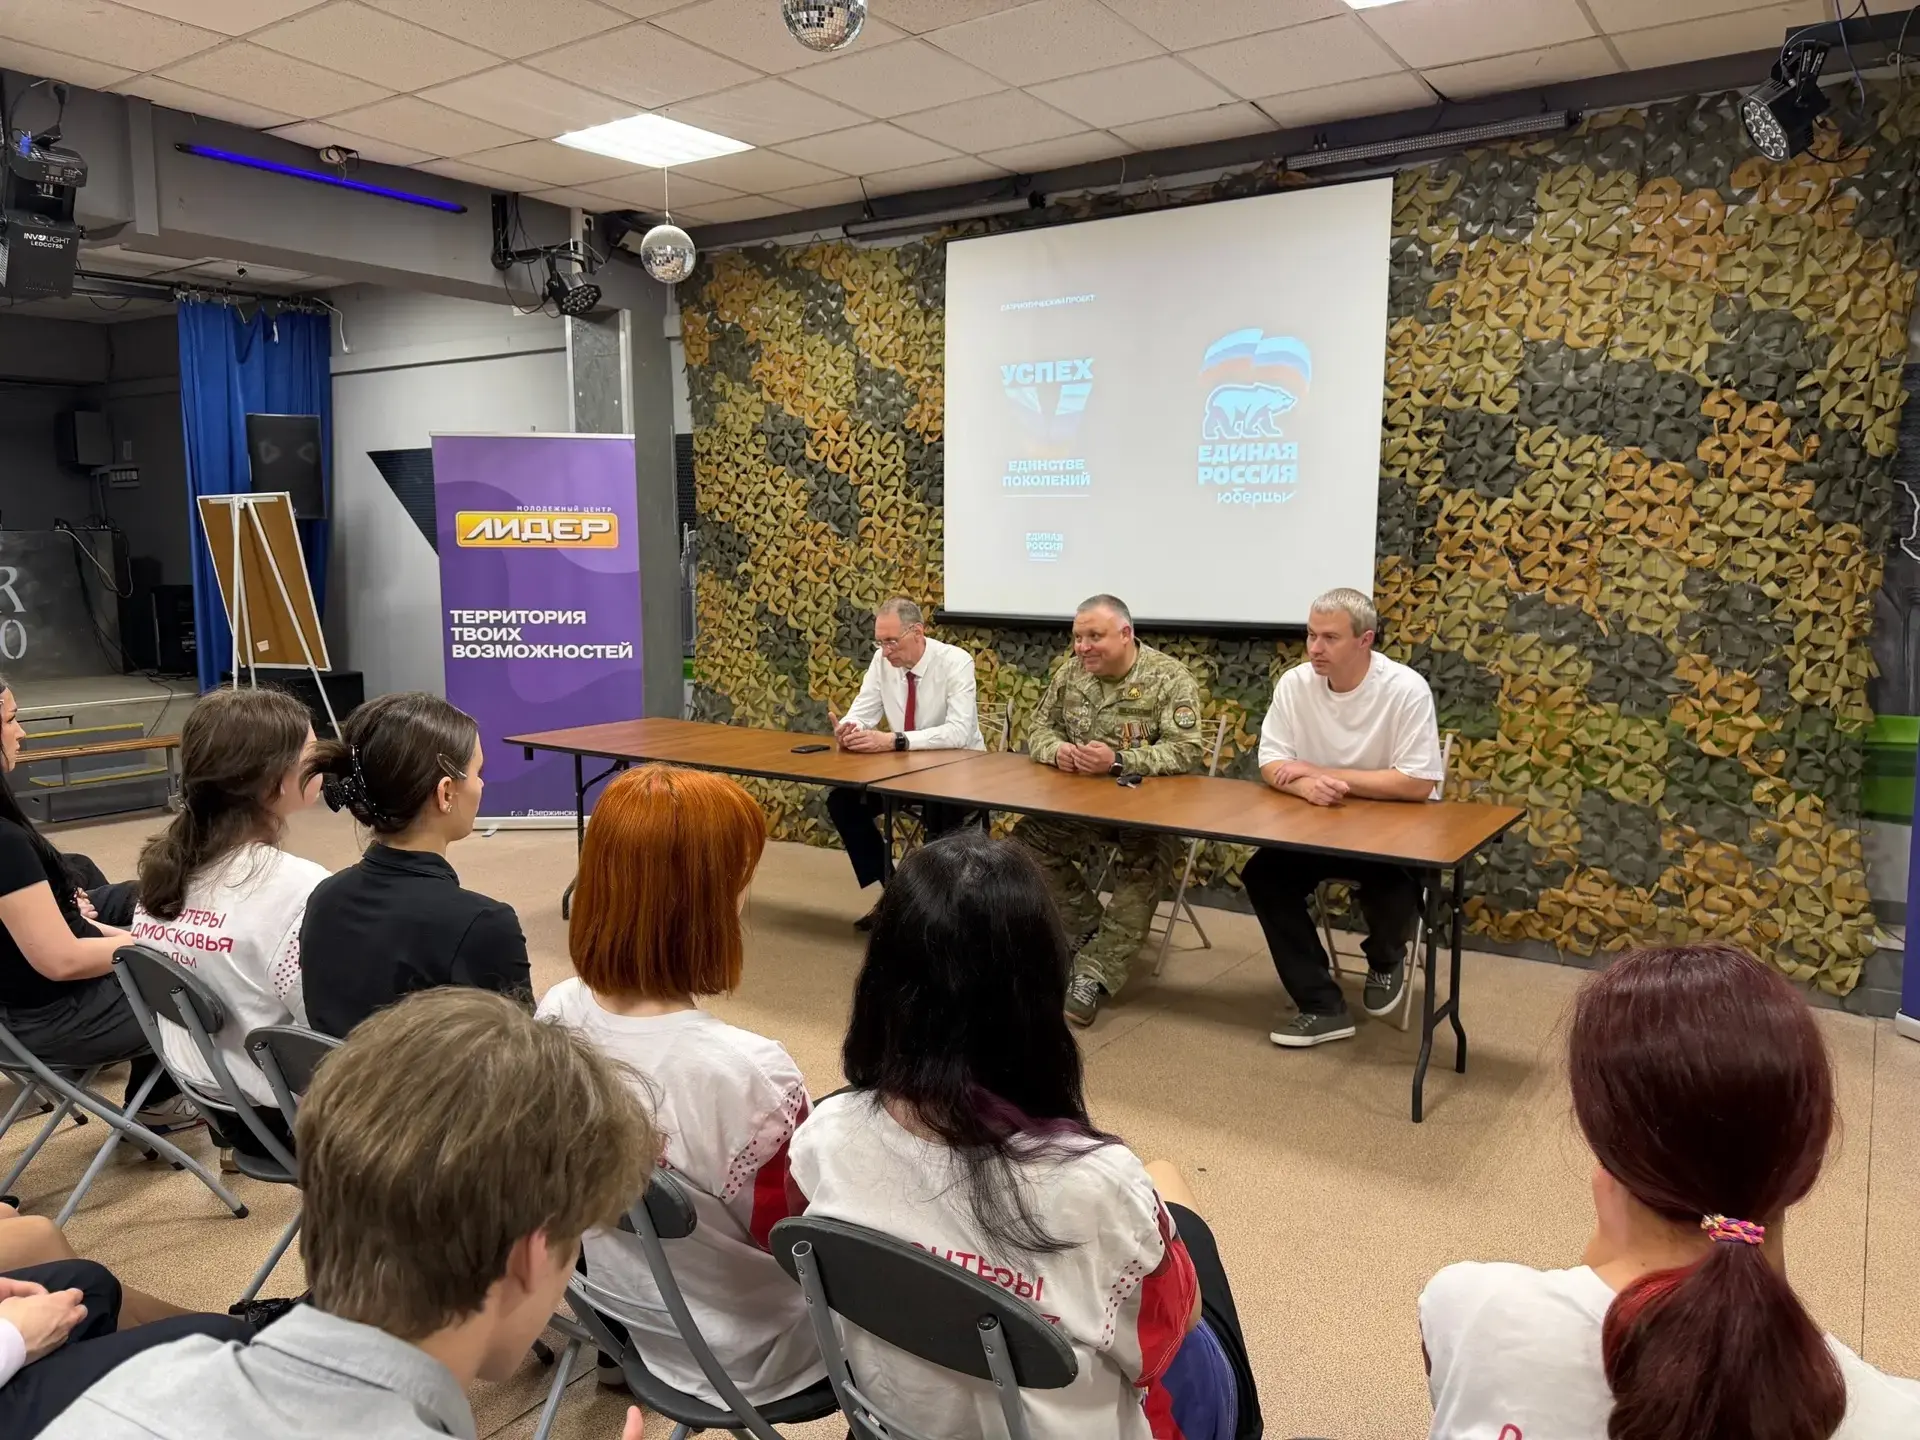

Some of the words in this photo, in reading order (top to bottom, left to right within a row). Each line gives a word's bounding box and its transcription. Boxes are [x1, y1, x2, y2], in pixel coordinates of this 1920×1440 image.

[23, 232, 71, 245] INVOLIGHT
[1000, 356, 1094, 386] УСПЕХ
[1198, 442, 1298, 465] ЕДИНАЯ
[1002, 471, 1090, 487] ПОКОЛЕНИЙ
[1198, 464, 1297, 486] РОССИЯ
[463, 517, 612, 543] ЛИДЕР
[450, 610, 587, 625] ТЕРРИТОРИЯ
[451, 627, 522, 641] ТВОИХ
[452, 641, 633, 659] ВОЗМОЖНОСТЕЙ
